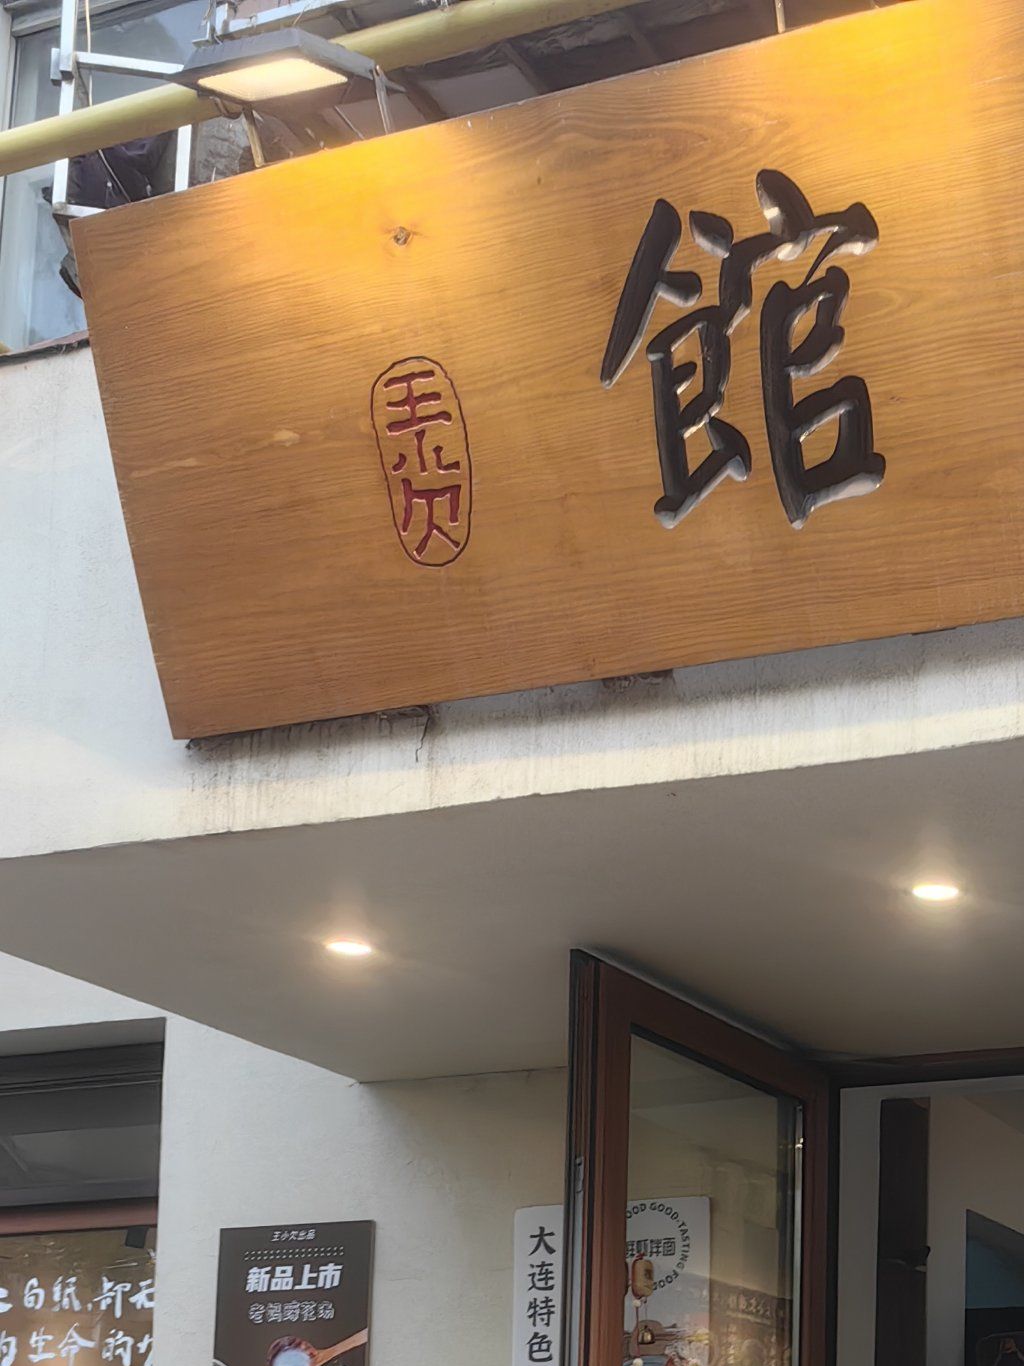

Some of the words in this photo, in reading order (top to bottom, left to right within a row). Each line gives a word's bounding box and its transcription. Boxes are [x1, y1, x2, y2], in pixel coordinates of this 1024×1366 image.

[245, 1262, 343, 1293] 新品上市
[527, 1225, 556, 1364] 大连特色
